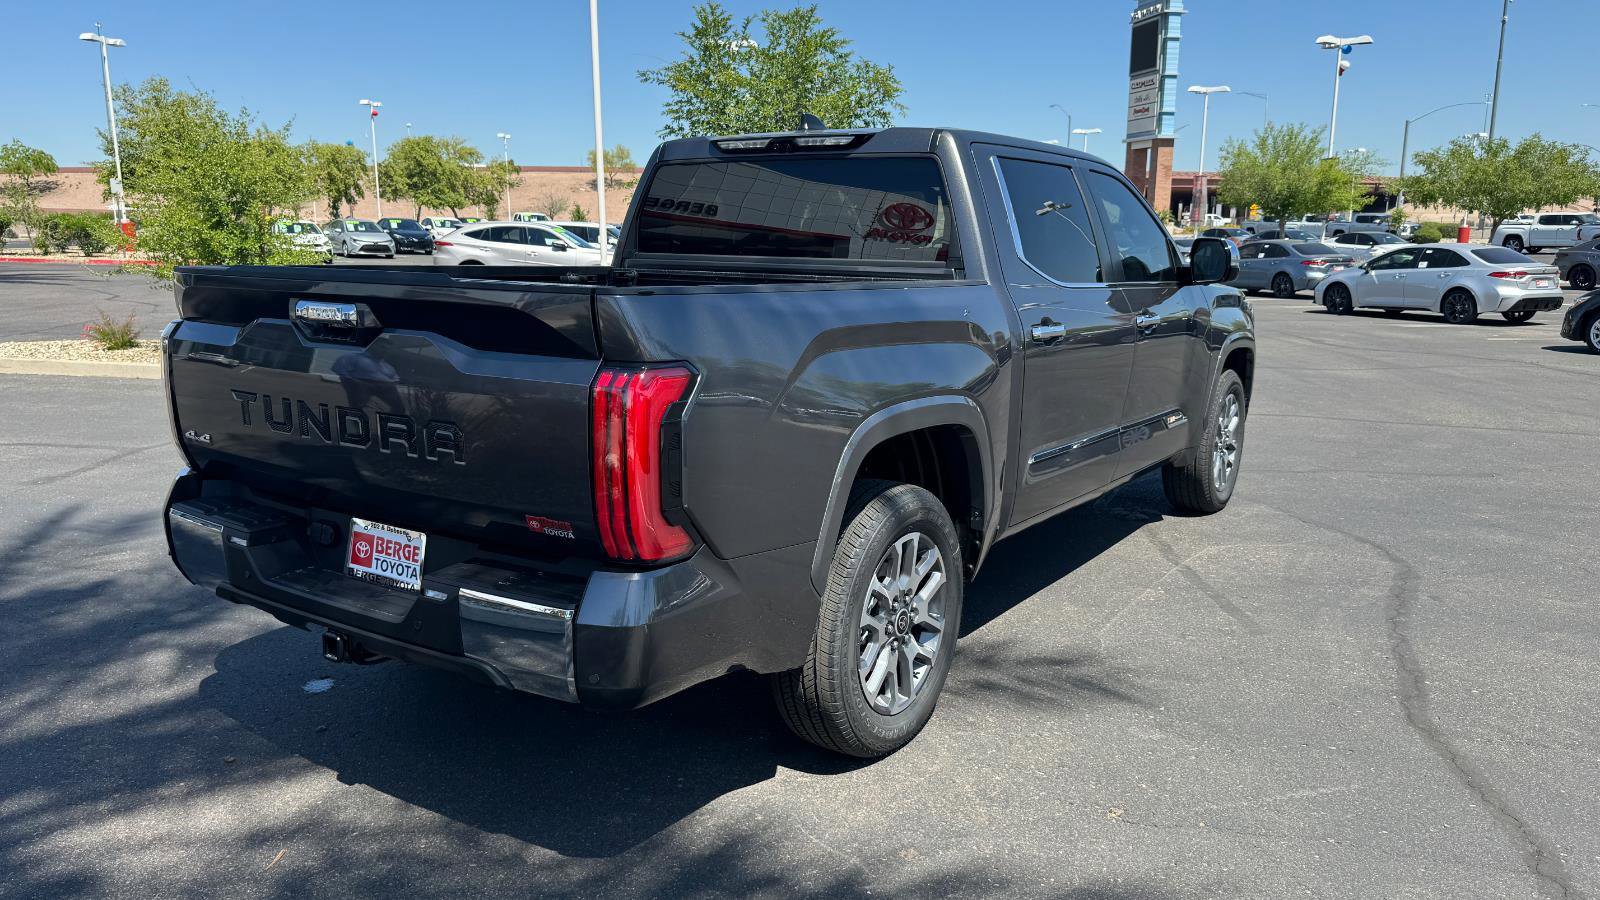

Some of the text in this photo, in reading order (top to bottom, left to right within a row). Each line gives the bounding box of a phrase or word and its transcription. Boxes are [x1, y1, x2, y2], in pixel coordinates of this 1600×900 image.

[231, 389, 466, 464] TUNDRA
[544, 527, 575, 539] TOYOTA
[375, 536, 420, 563] BERGE
[374, 558, 418, 581] TOYOTA
